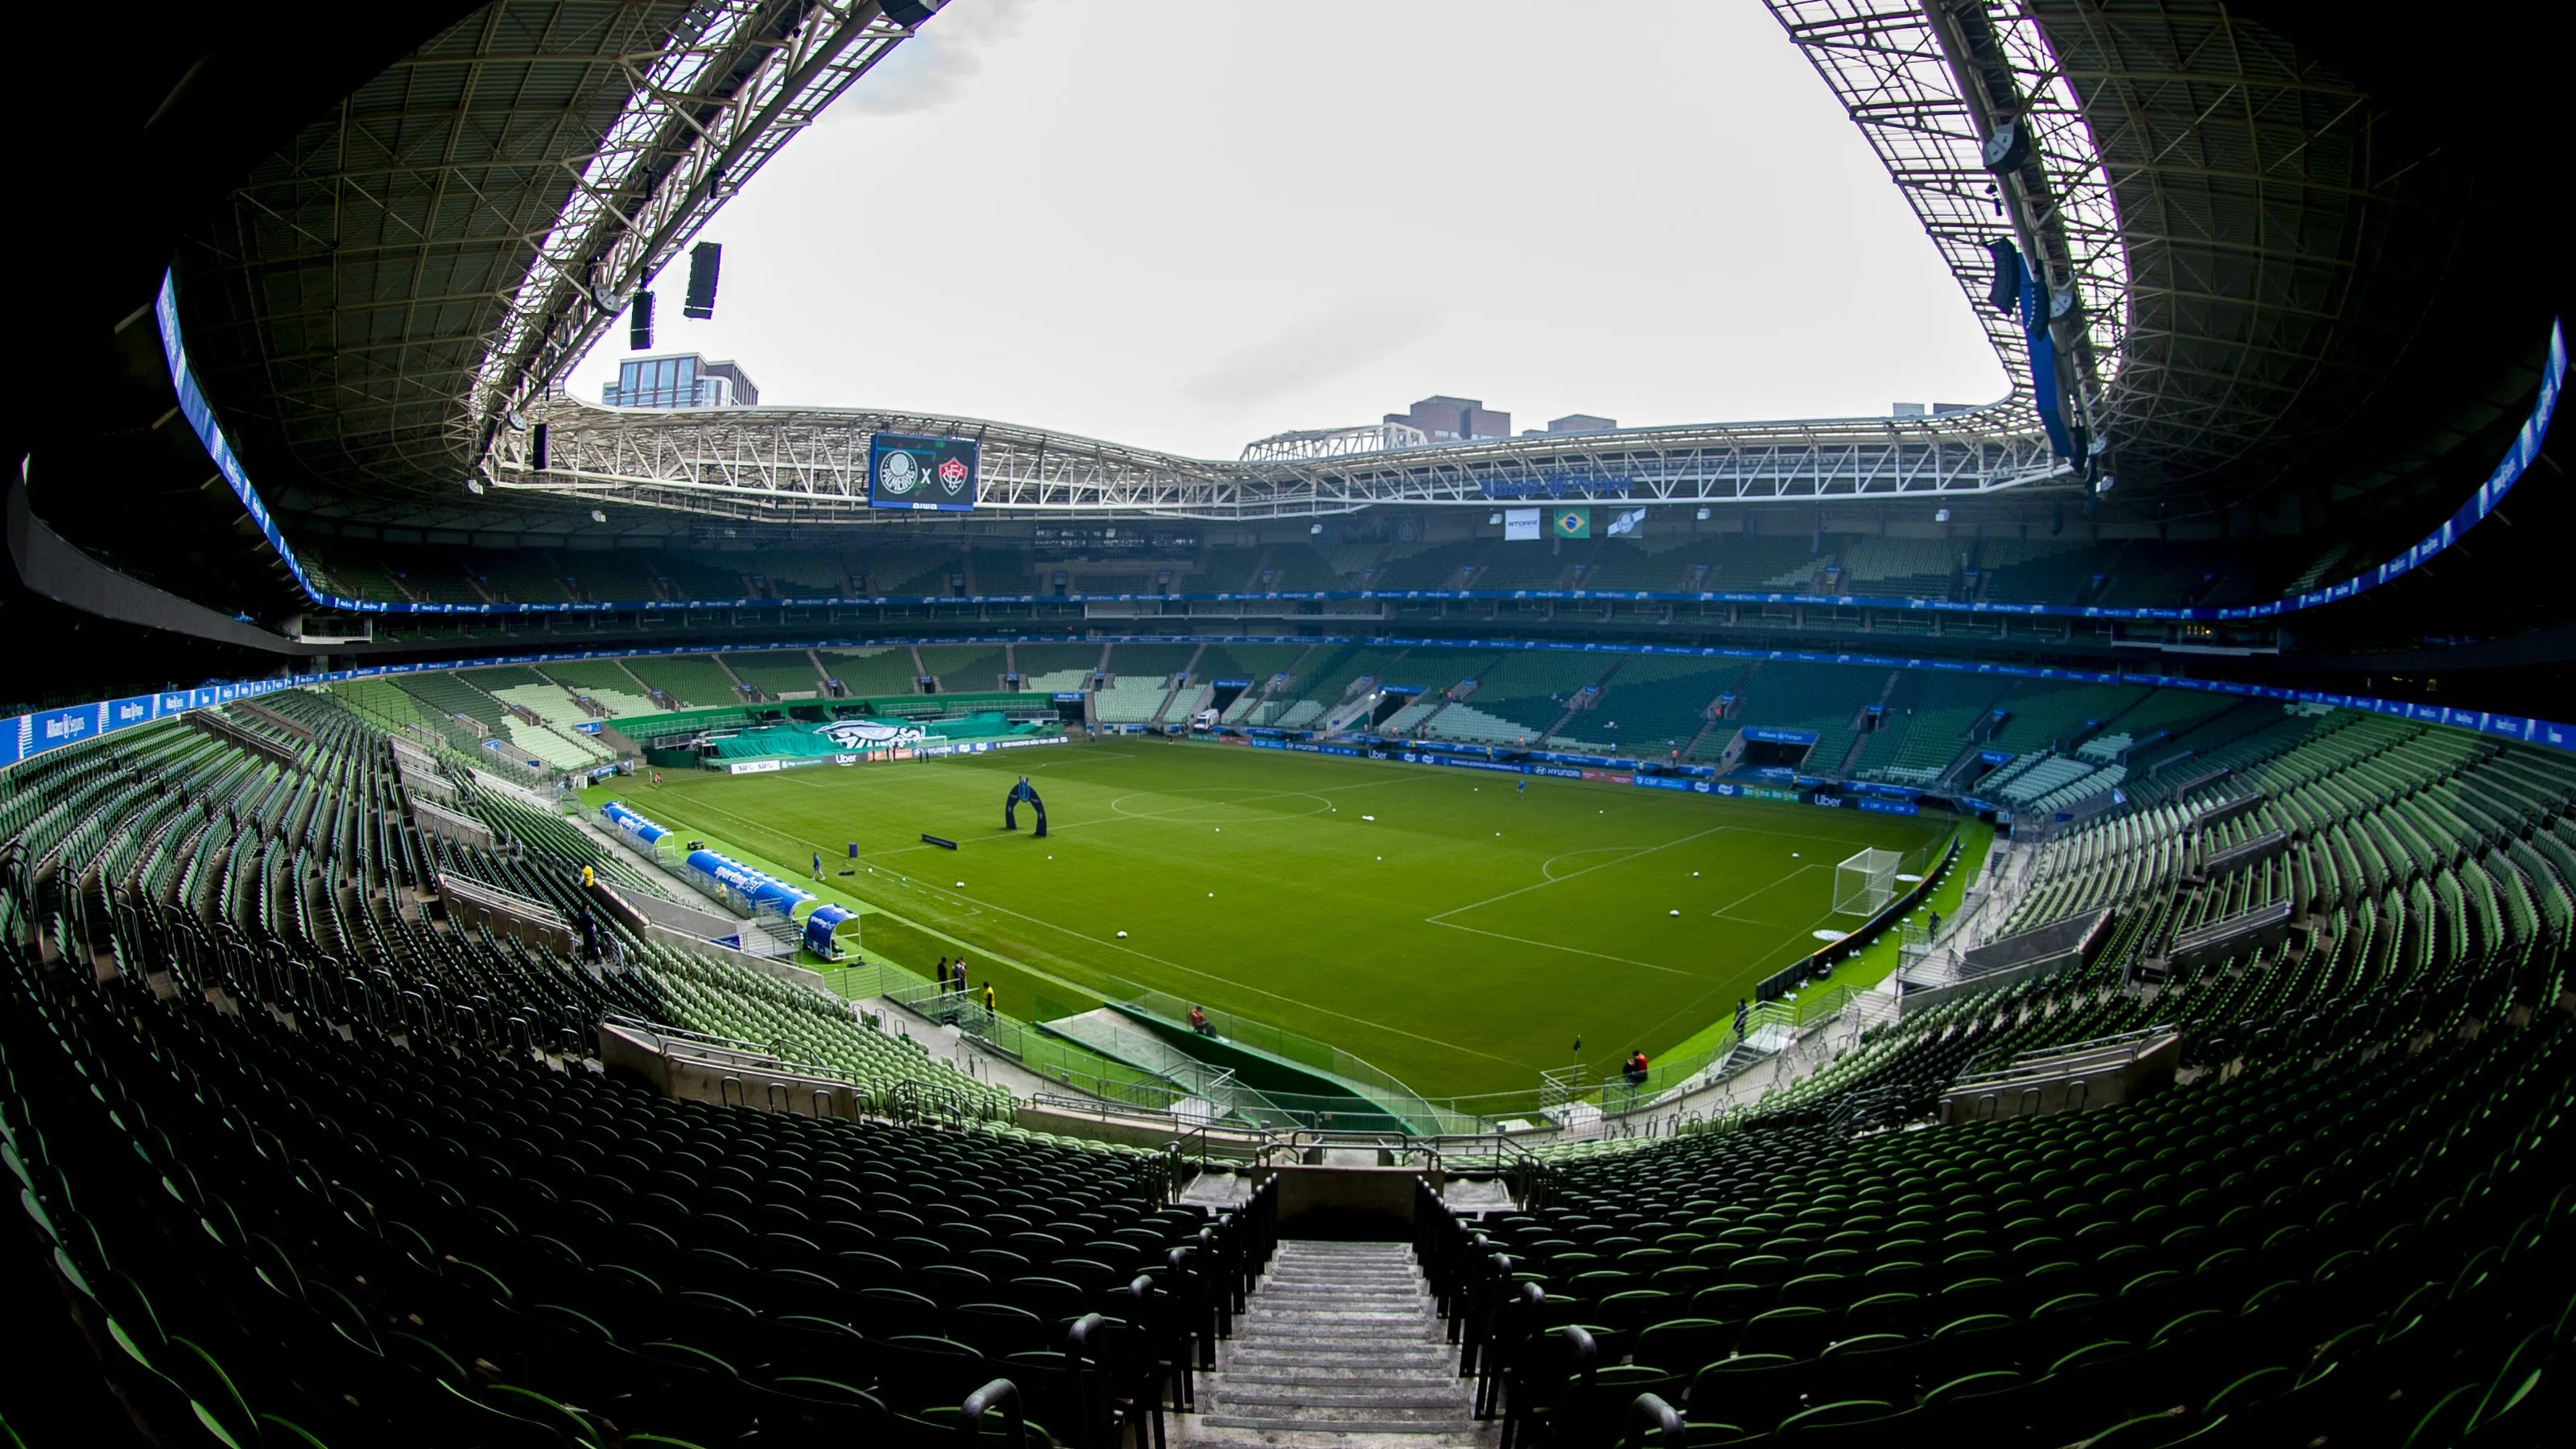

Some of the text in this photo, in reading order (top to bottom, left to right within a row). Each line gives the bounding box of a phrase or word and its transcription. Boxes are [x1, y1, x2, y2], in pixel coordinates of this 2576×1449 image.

[882, 469, 915, 491] PALMEIRAS
[836, 754, 857, 763] Uber
[1368, 750, 1387, 759] Uber
[1547, 768, 1581, 778] HYUNDAI
[1814, 794, 1842, 807] Uber
[715, 866, 766, 894] sportingbet
